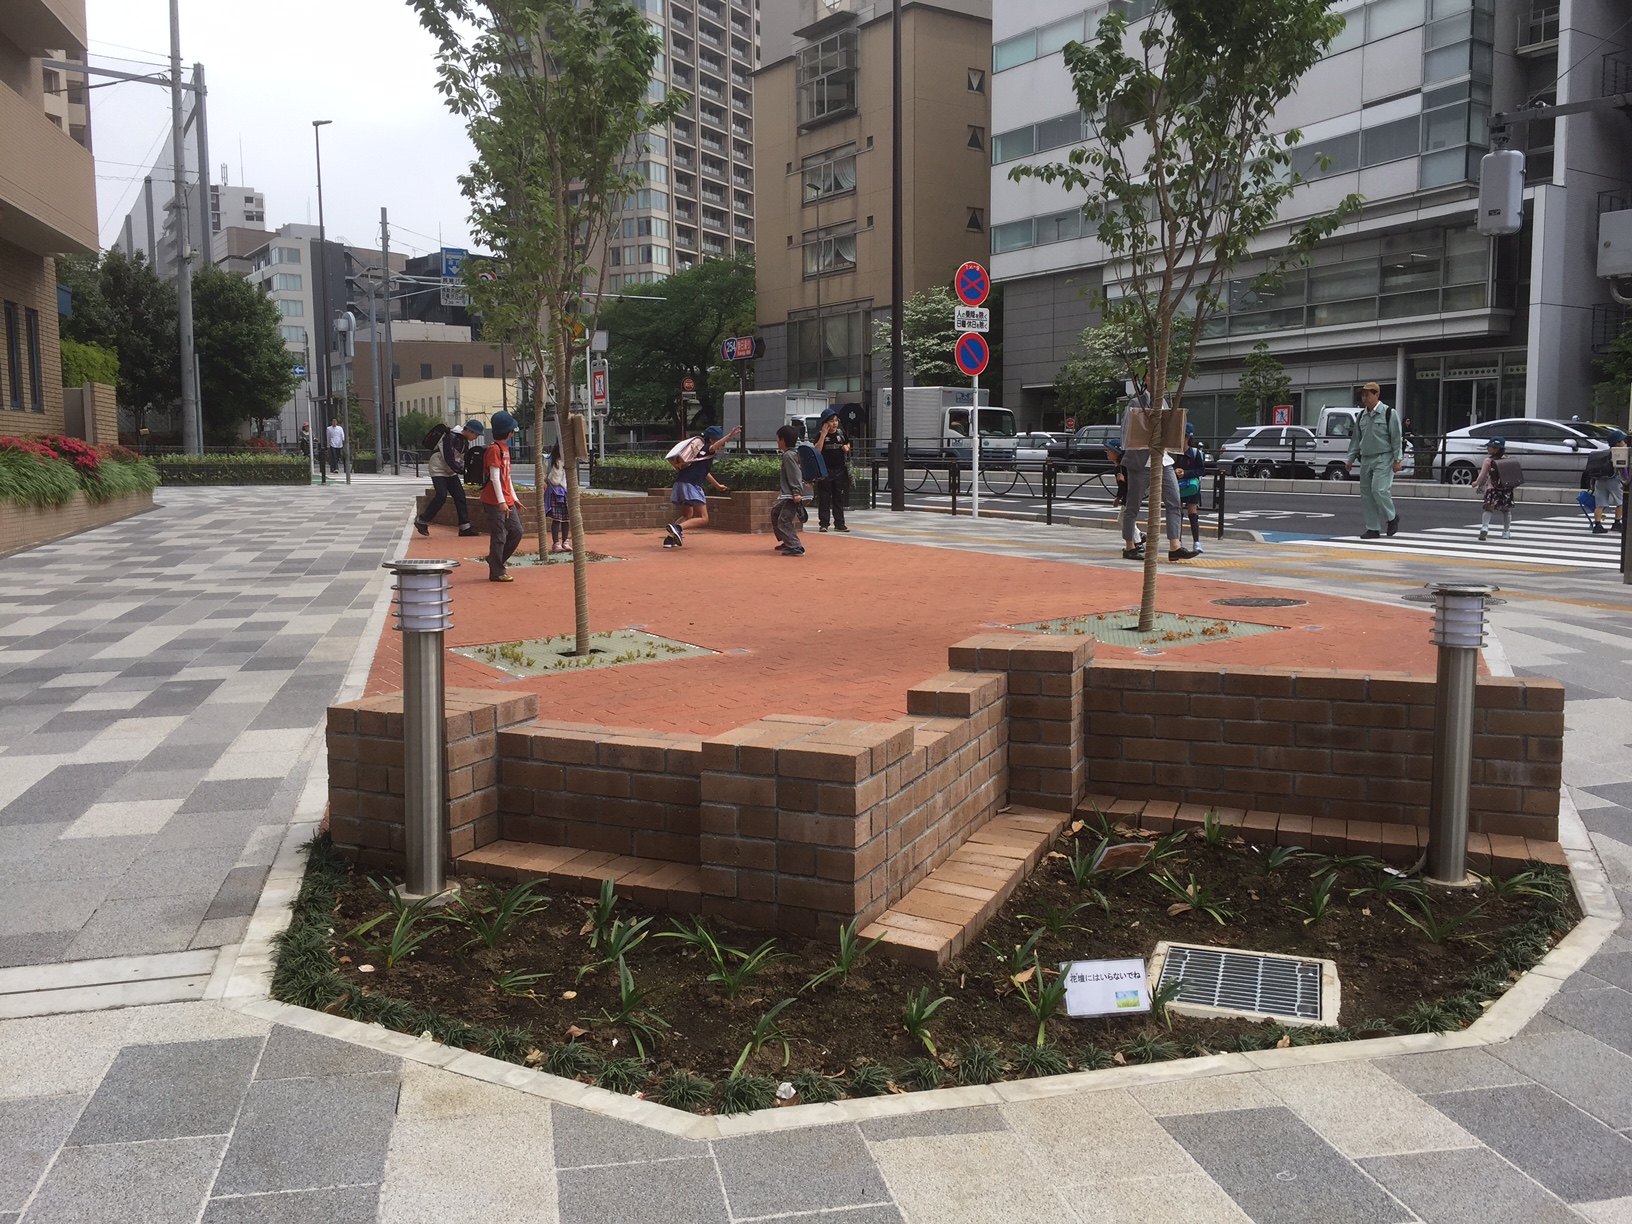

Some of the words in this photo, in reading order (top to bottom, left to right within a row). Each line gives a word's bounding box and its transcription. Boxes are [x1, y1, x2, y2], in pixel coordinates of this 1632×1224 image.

[1070, 971, 1141, 983] 花壇にはいらないでね
